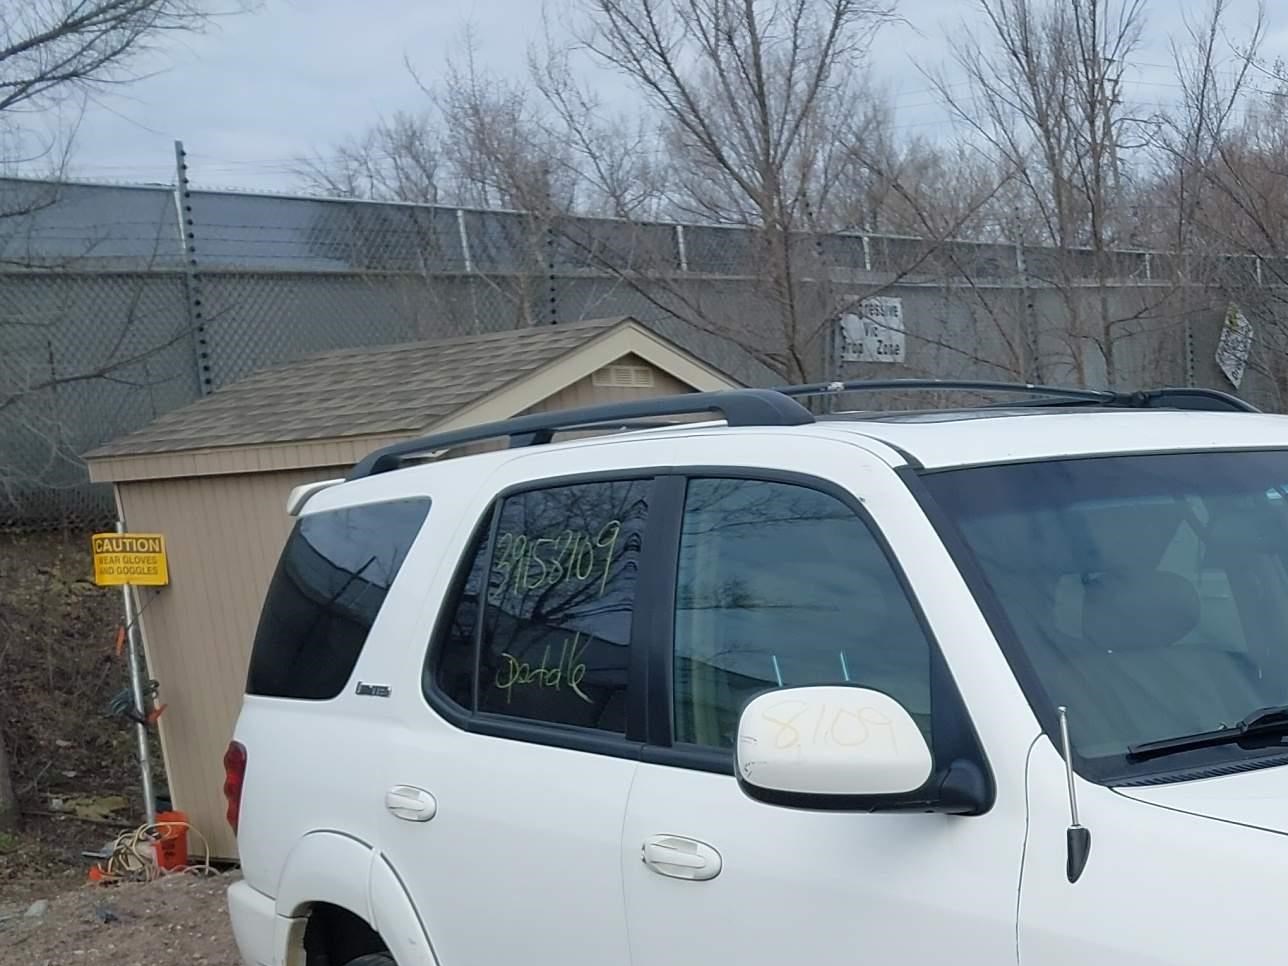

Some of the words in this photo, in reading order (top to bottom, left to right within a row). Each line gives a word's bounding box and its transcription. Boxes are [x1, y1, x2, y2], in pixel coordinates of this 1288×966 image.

[95, 539, 160, 553] CAUTION
[122, 555, 158, 565] GLOVES
[762, 699, 898, 755] 8109
